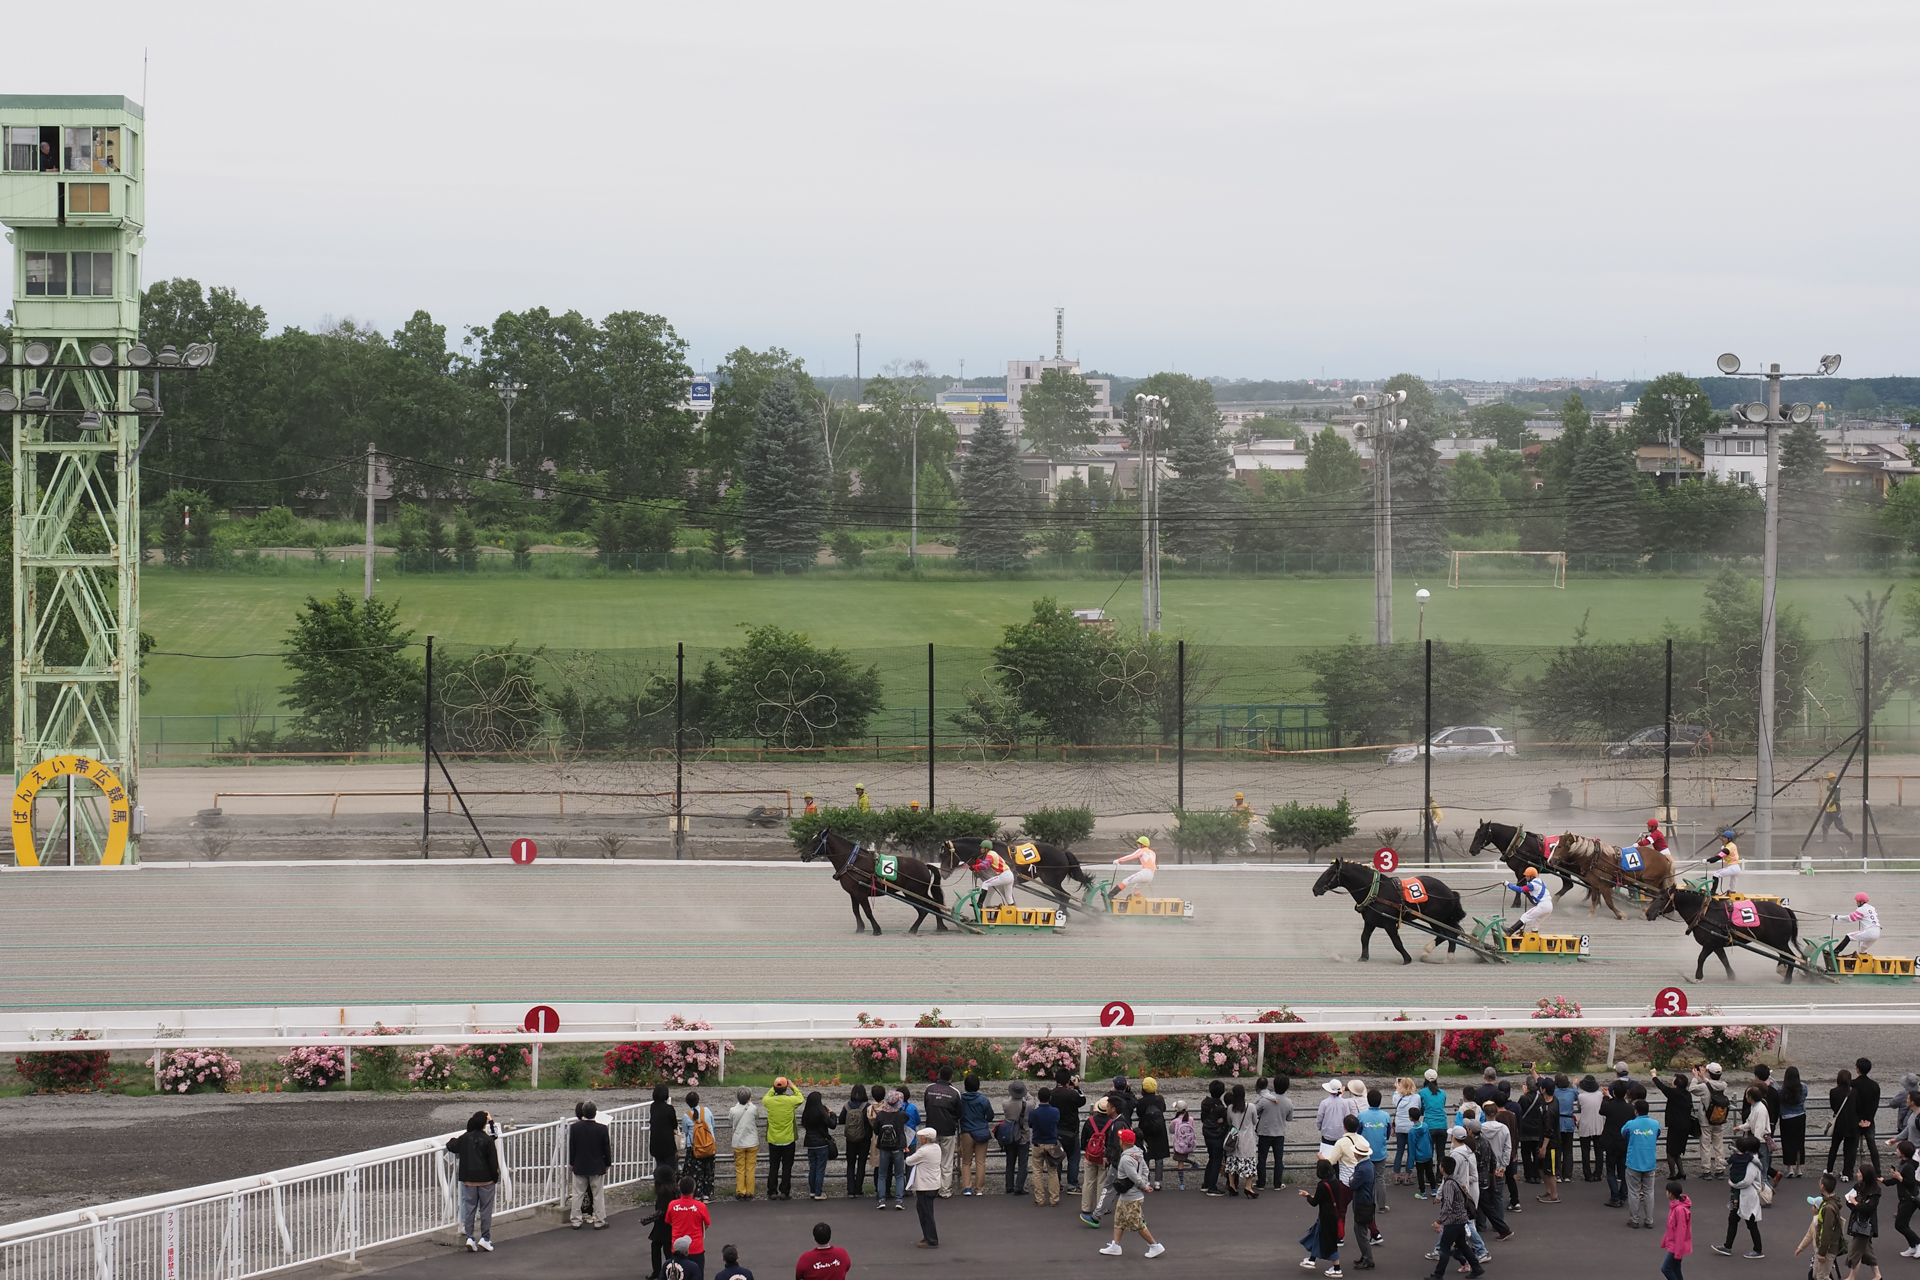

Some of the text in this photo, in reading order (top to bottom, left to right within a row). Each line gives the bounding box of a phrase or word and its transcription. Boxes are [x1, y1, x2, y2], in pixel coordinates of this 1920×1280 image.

[13, 758, 127, 823] ばんえい帯広競馬
[521, 841, 527, 861] 1
[1020, 846, 1036, 861] 5
[1380, 851, 1393, 870] 3
[1629, 853, 1639, 866] 4
[883, 862, 894, 874] 6
[1409, 884, 1423, 899] 8
[1184, 901, 1191, 910] 5
[1780, 898, 1789, 906] 4
[1056, 910, 1064, 920] 6
[1581, 935, 1589, 947] 8
[1663, 991, 1680, 1015] 3
[538, 1009, 545, 1033] 1
[1108, 1005, 1126, 1027] 2
[167, 1212, 175, 1278] フラッシュ撮影禁止
